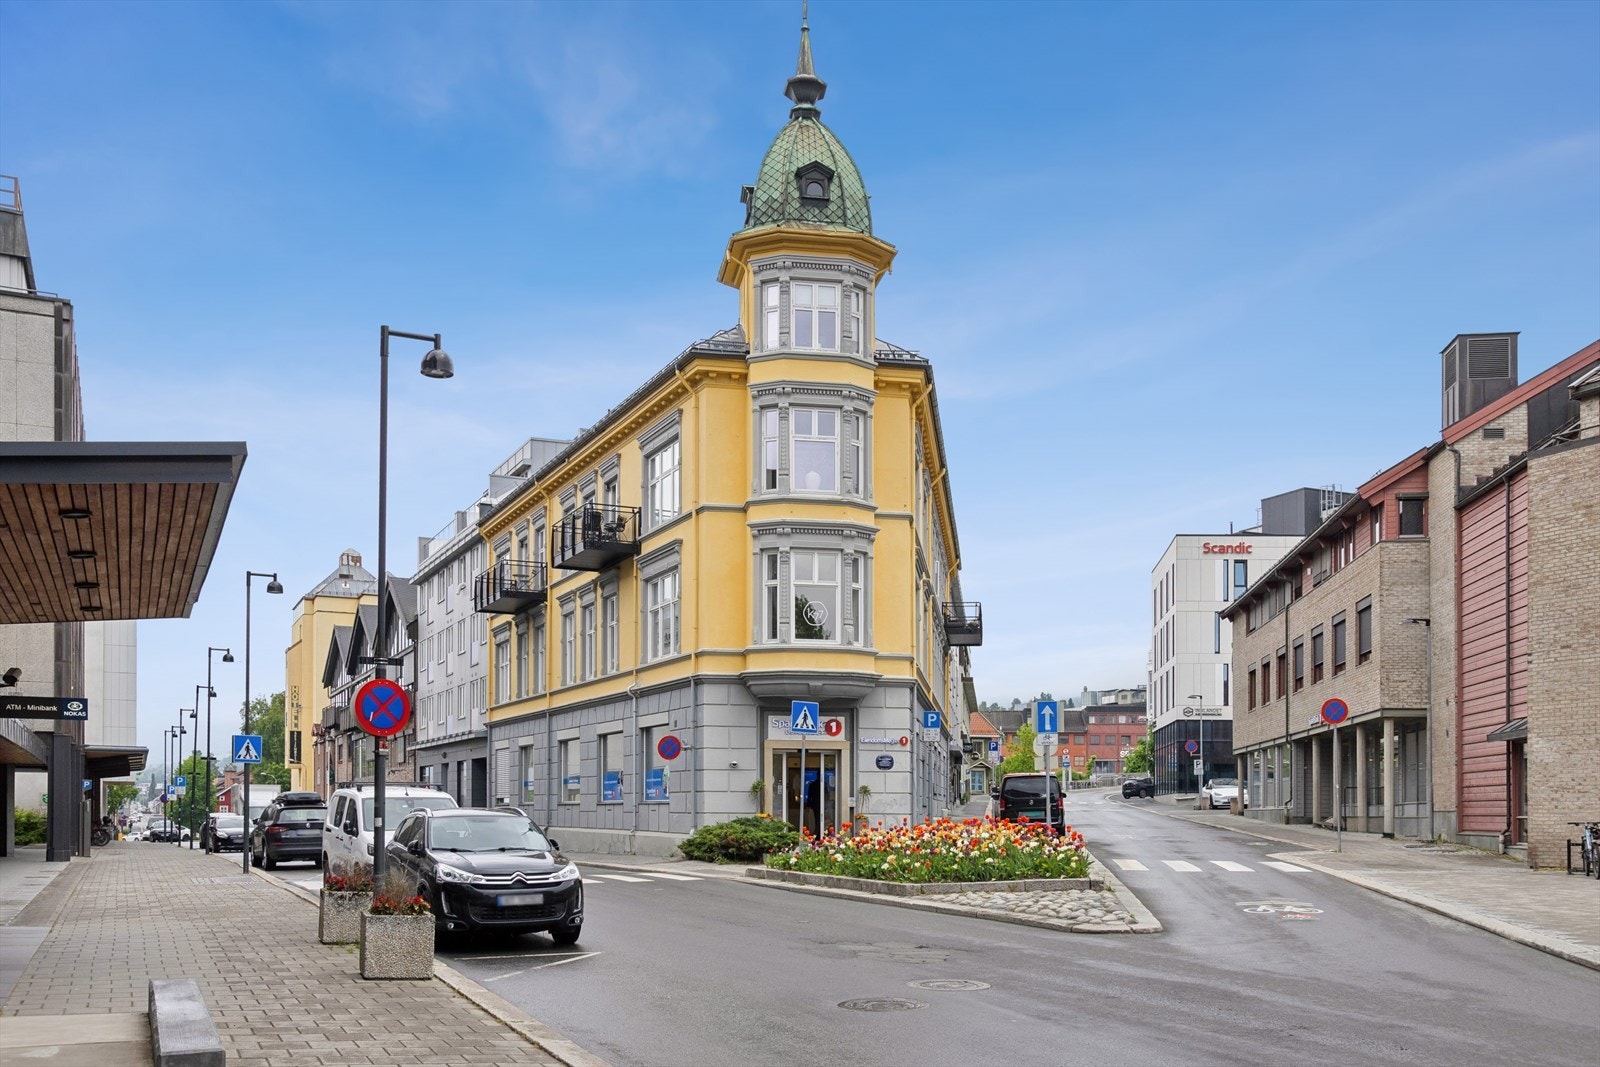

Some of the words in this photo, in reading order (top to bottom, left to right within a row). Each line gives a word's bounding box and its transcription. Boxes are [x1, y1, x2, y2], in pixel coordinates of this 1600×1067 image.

[1203, 542, 1253, 554] Scandic
[27, 704, 58, 712] Minibank
[927, 713, 938, 727] P
[990, 742, 997, 750] P
[177, 776, 184, 784] P
